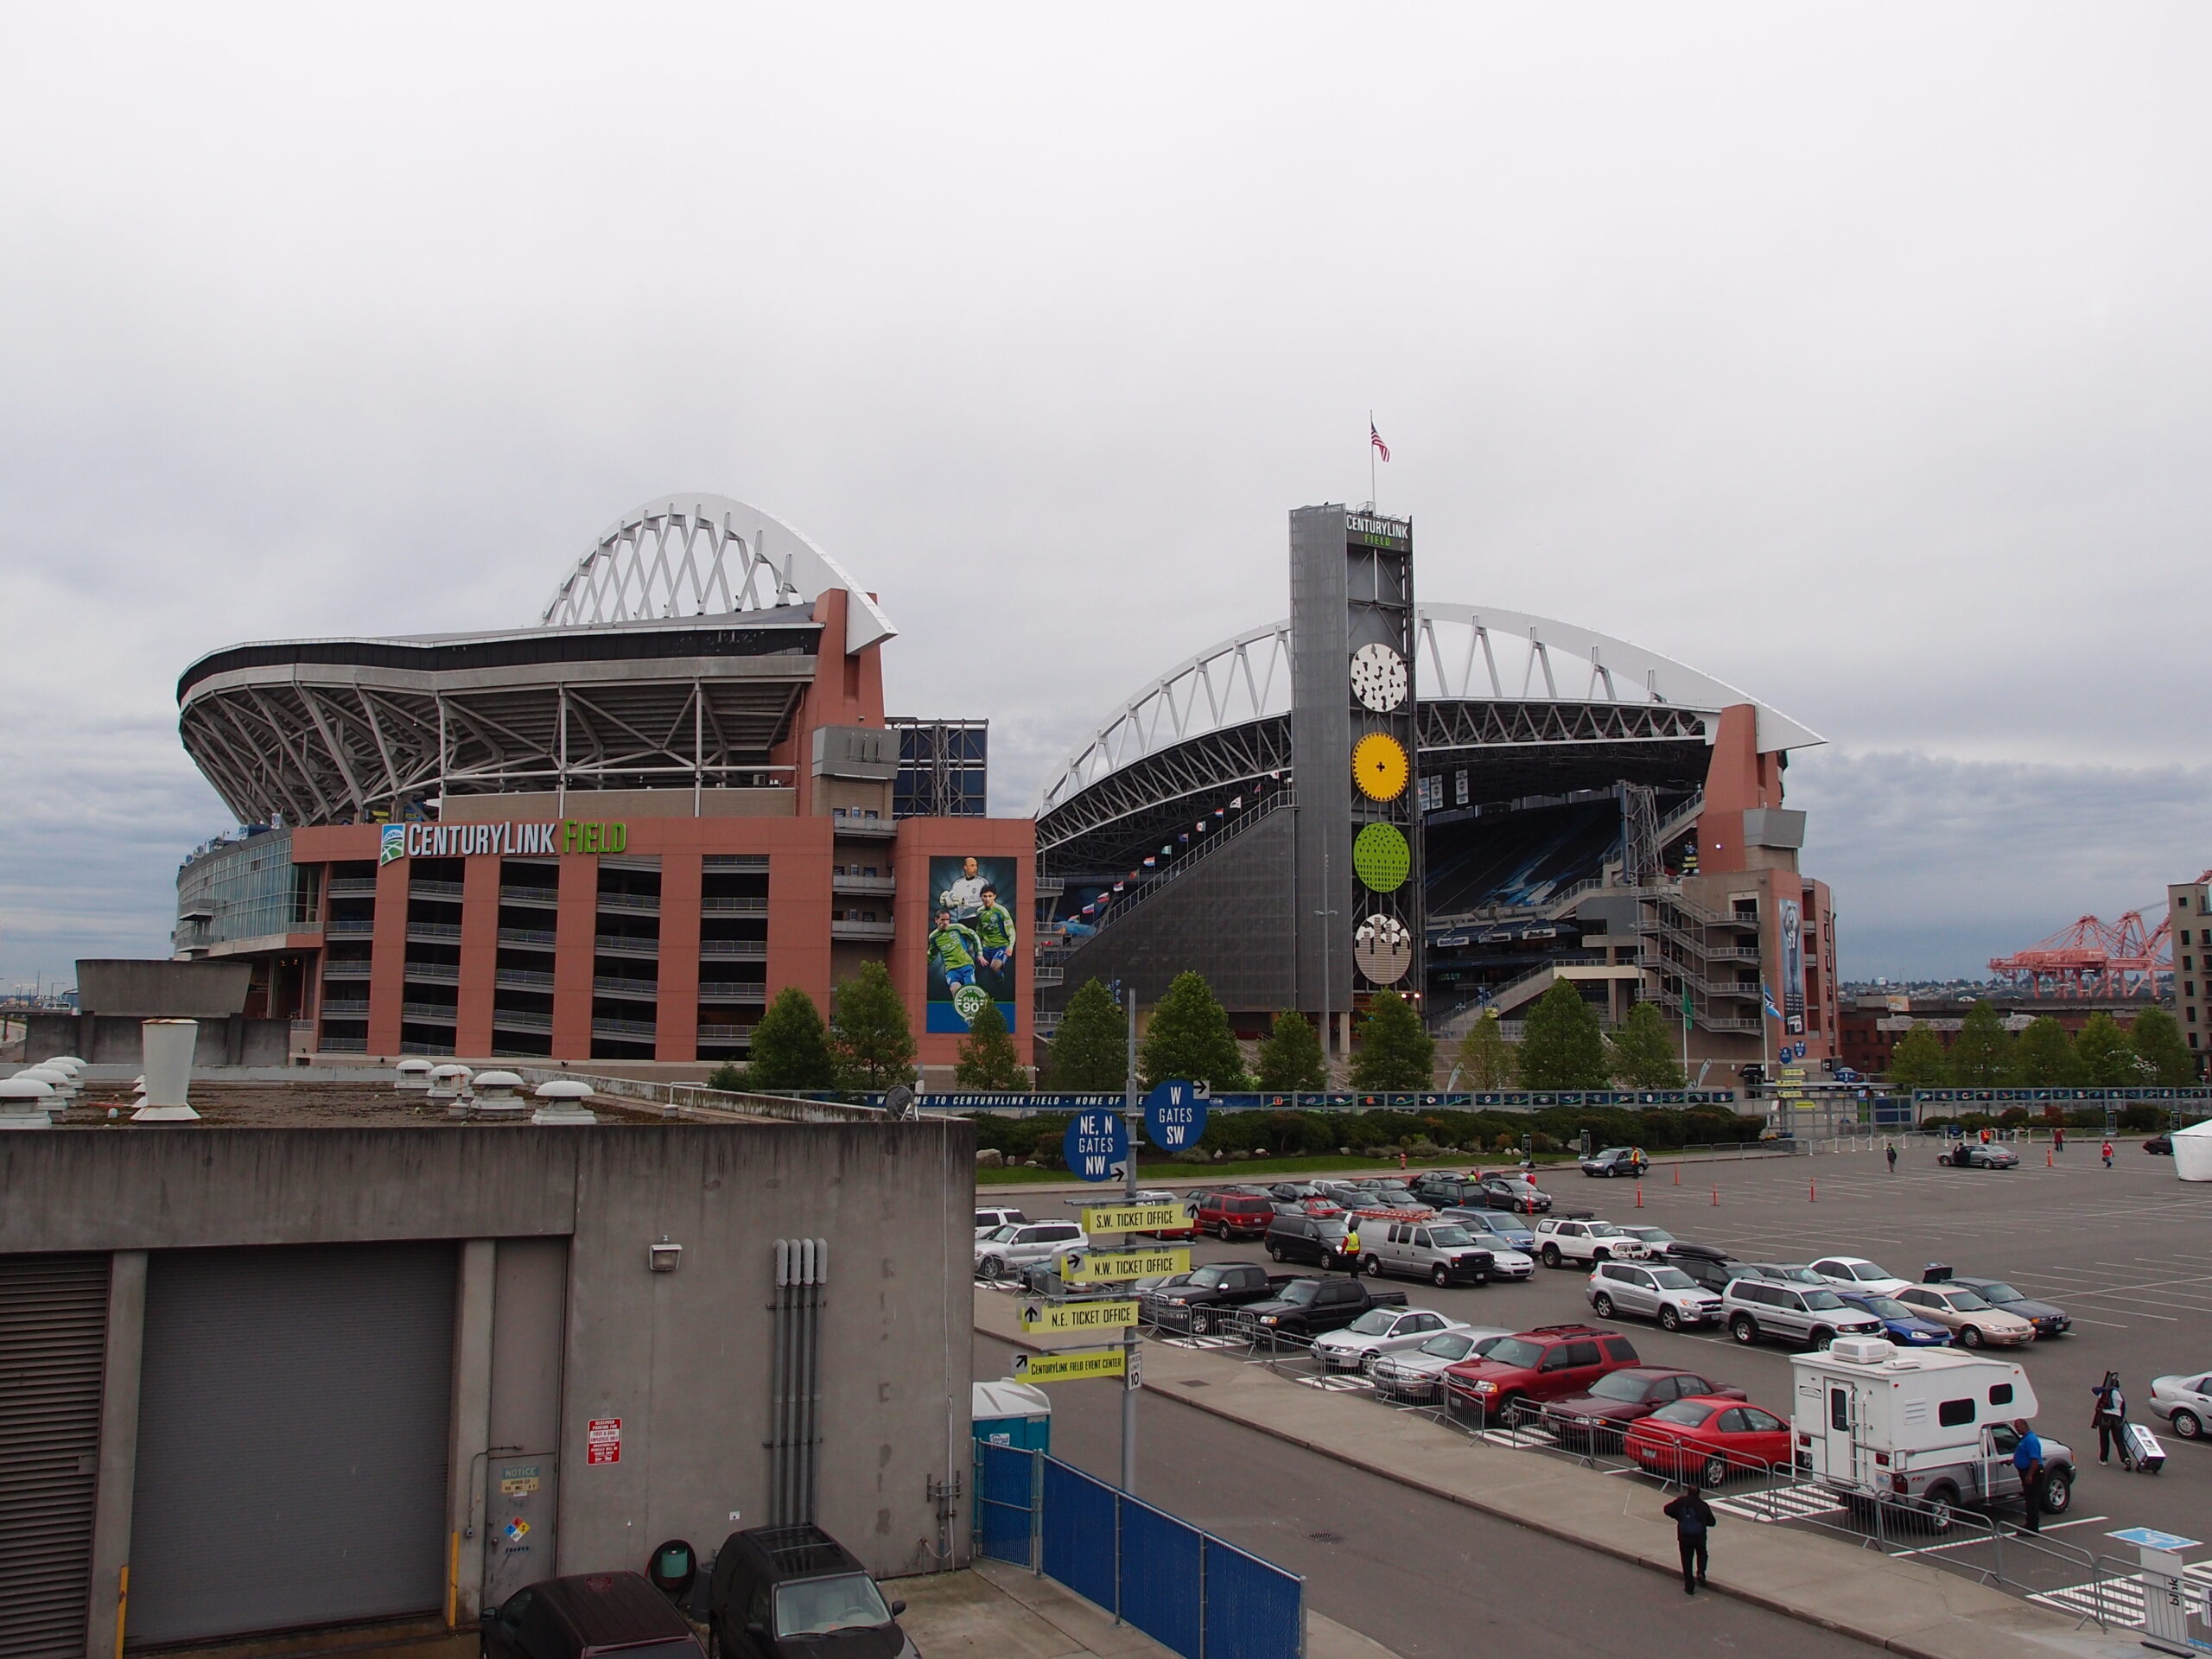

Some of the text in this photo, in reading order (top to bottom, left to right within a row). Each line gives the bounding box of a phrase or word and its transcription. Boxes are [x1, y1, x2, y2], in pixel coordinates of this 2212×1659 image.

[1364, 534, 1391, 547] FIELD
[563, 821, 627, 854] FIELD
[963, 1002, 979, 1013] 90
[935, 1096, 947, 1105] TO
[952, 1096, 1025, 1106] CENTURYLINK
[1029, 1096, 1060, 1106] FIELD
[1075, 1096, 1103, 1106] HOME
[1108, 1096, 1121, 1106] OF
[1170, 1086, 1182, 1105] W
[1159, 1108, 1192, 1123] GATES
[1104, 1116, 1113, 1135] N
[1166, 1126, 1185, 1145] SW
[1078, 1137, 1114, 1154] GATES
[1085, 1155, 1106, 1175] NW
[1096, 1211, 1173, 1229] S.W. TICKET OFFICE
[1094, 1258, 1173, 1276] N.W. TICKET OFFICE
[1052, 1307, 1131, 1327] N.E. TICKET OFFICE
[1070, 1360, 1084, 1371] FIELD
[1085, 1359, 1101, 1370] EVENT
[1102, 1357, 1122, 1369] CENTER
[1130, 1372, 1140, 1387] 10
[505, 1466, 536, 1478] NOTICE
